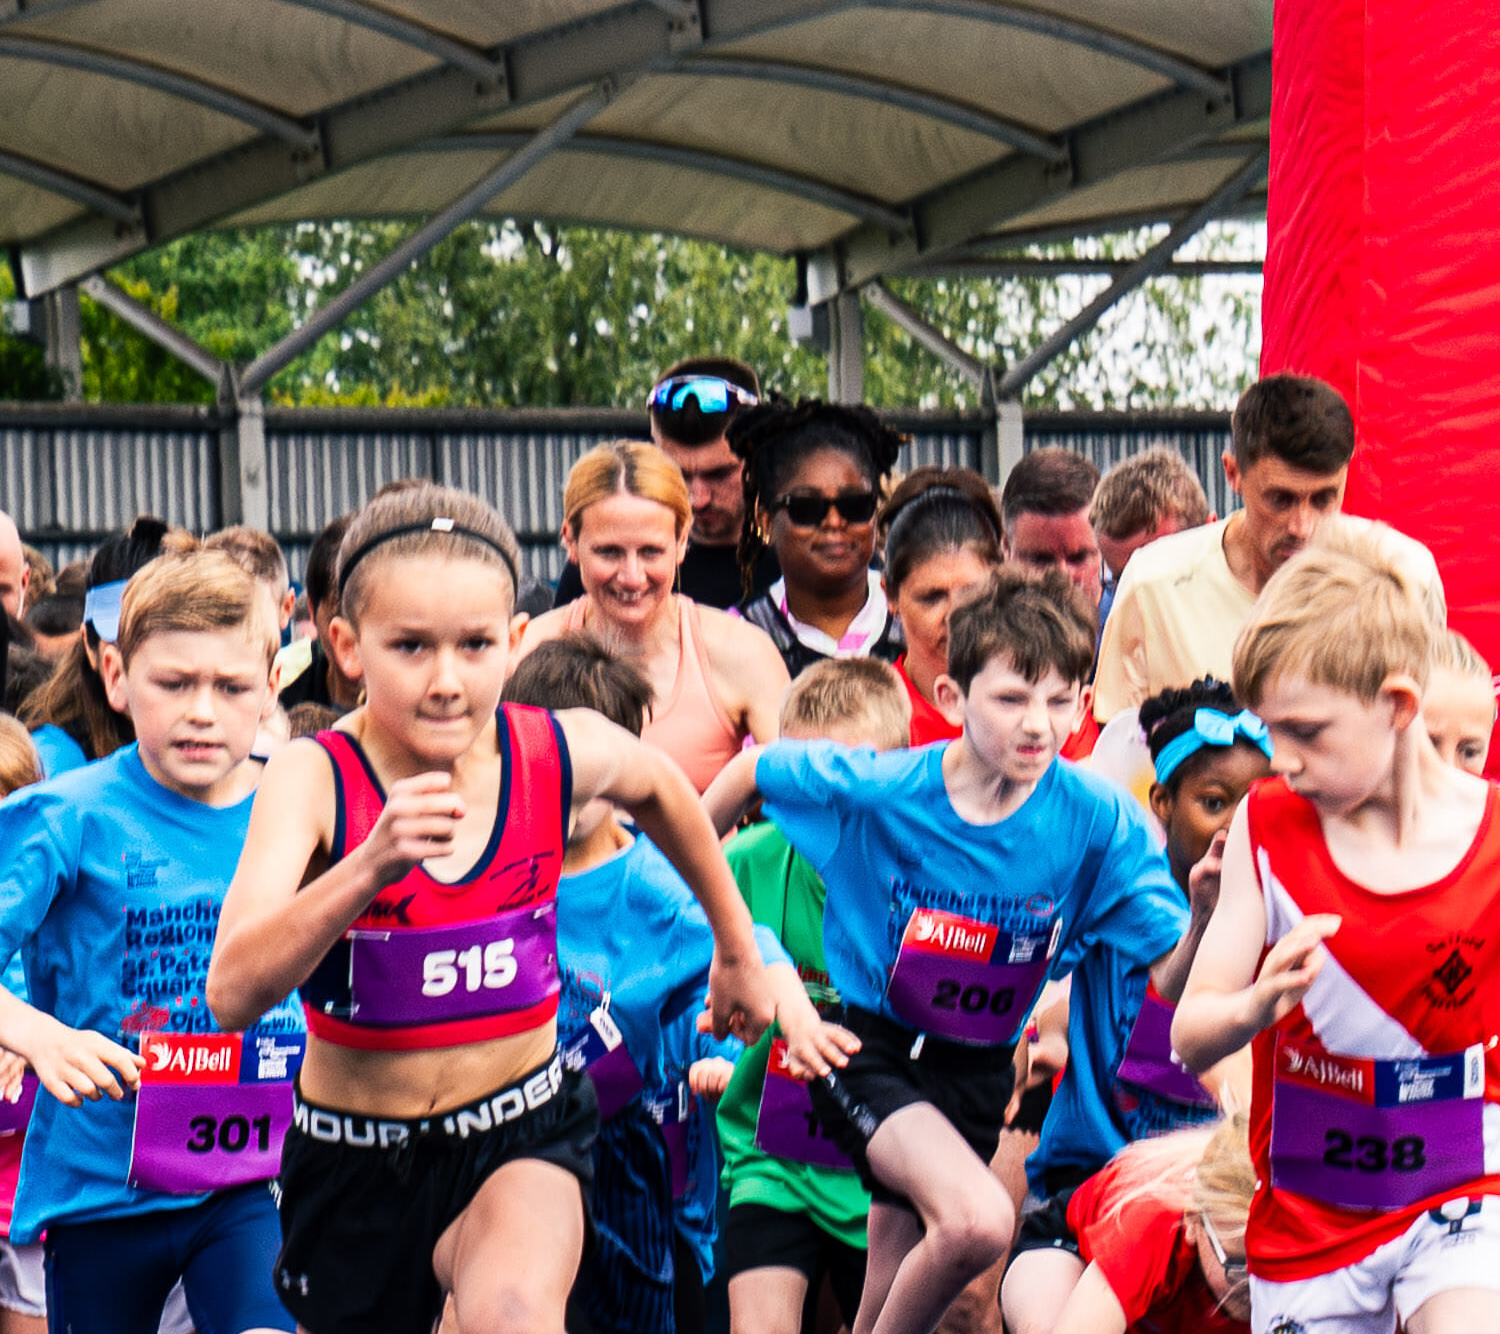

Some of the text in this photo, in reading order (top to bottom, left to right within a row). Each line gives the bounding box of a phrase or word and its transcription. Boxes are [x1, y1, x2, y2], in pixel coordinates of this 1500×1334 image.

[421, 937, 518, 997] 515
[187, 1115, 272, 1154] 301
[1321, 1129, 1427, 1174] 238
